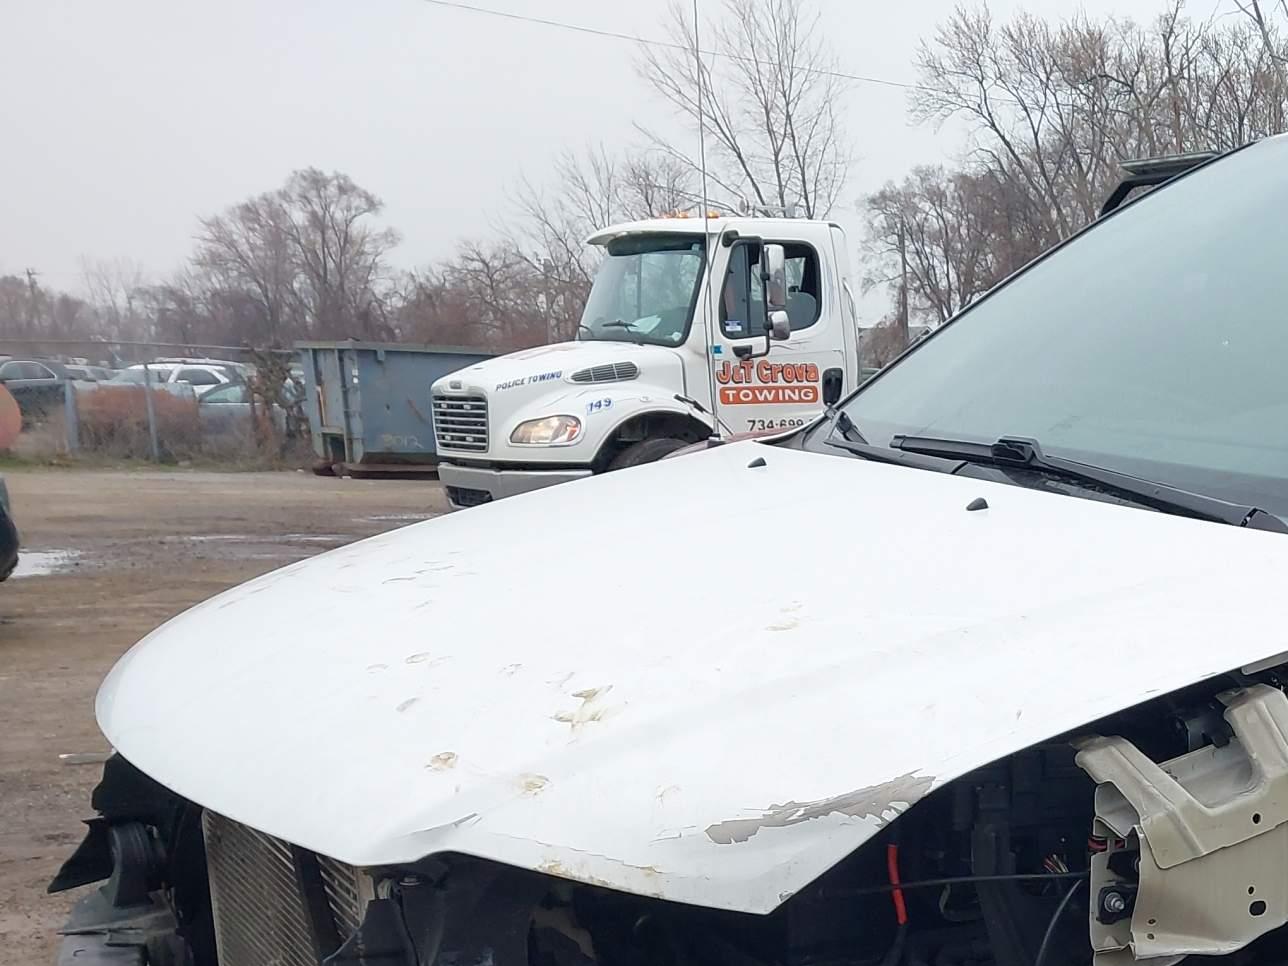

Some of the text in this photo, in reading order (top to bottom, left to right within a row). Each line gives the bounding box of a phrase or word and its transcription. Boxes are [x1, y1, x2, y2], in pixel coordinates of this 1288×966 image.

[495, 370, 563, 391] POLICE TOWING
[716, 360, 819, 385] J&T Crova
[724, 388, 814, 402] TOWING
[589, 398, 612, 412] 149
